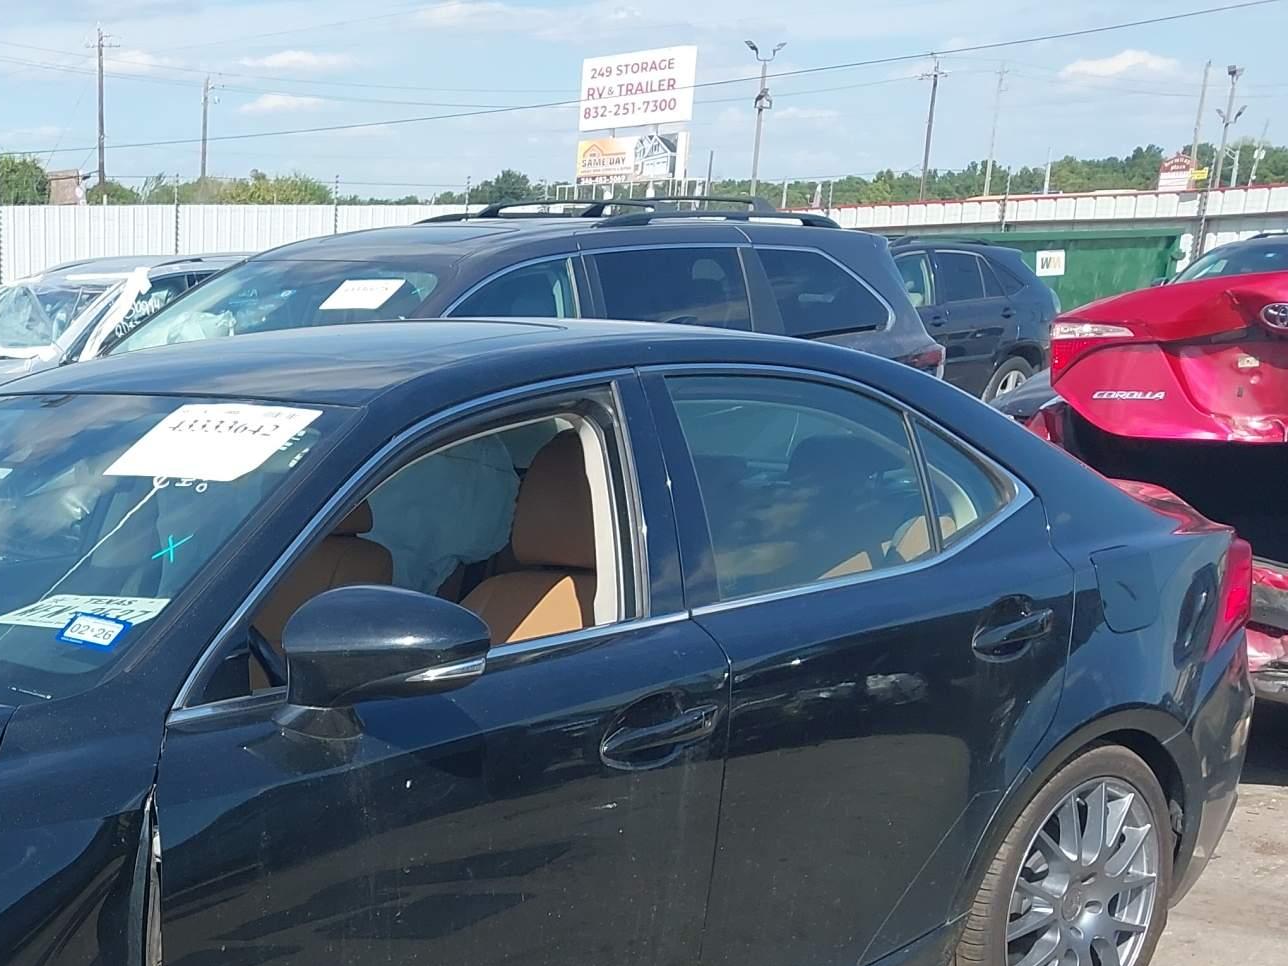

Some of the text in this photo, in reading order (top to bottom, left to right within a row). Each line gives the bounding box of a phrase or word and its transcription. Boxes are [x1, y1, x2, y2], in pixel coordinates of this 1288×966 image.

[590, 58, 675, 80] 249 STORAGE
[587, 78, 676, 101] RV & TRAILER
[583, 98, 677, 120] 832-251-7300
[1092, 390, 1166, 400] COROLLA
[83, 598, 138, 606] TEXAS
